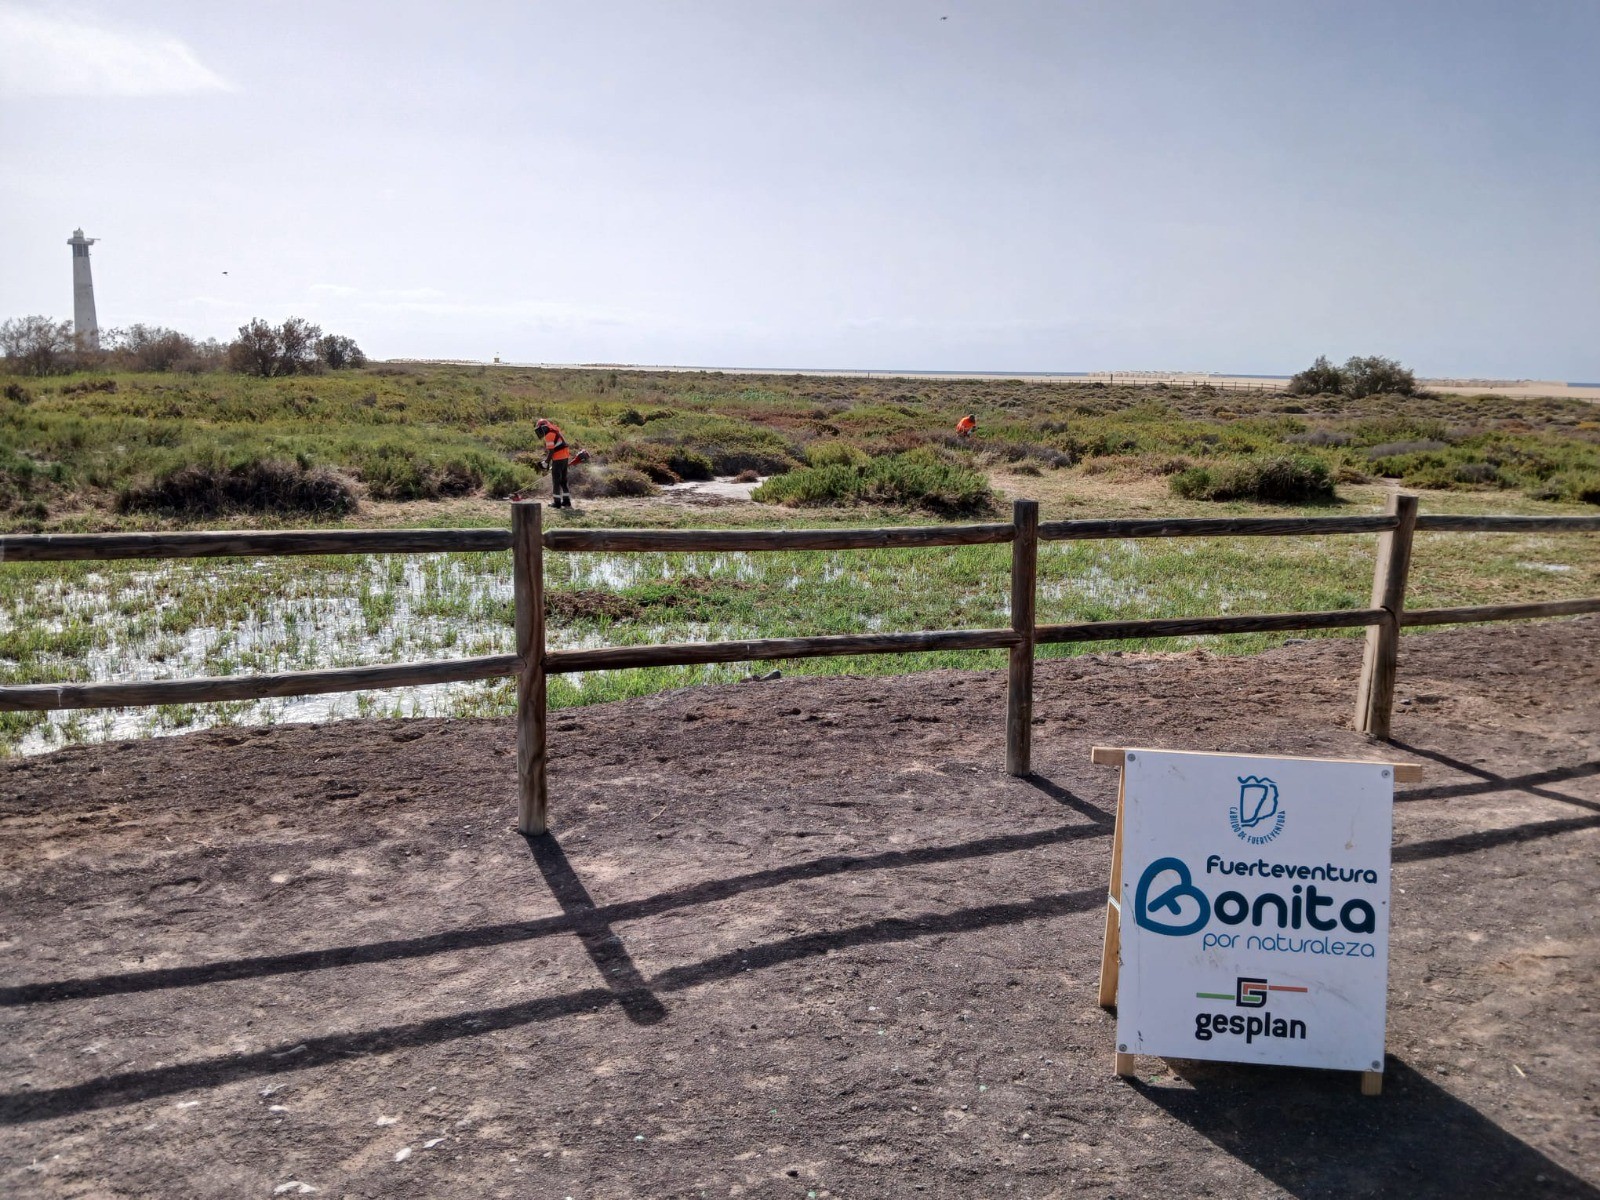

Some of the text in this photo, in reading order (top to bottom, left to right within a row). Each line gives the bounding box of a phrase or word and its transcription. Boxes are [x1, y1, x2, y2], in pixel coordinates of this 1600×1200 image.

[1229, 806, 1286, 845] CABILDO DE FUERTEVENTURA
[1134, 856, 1376, 937] Bonita
[1202, 933, 1375, 958] por naturaleza
[1195, 1012, 1307, 1044] gesplan
